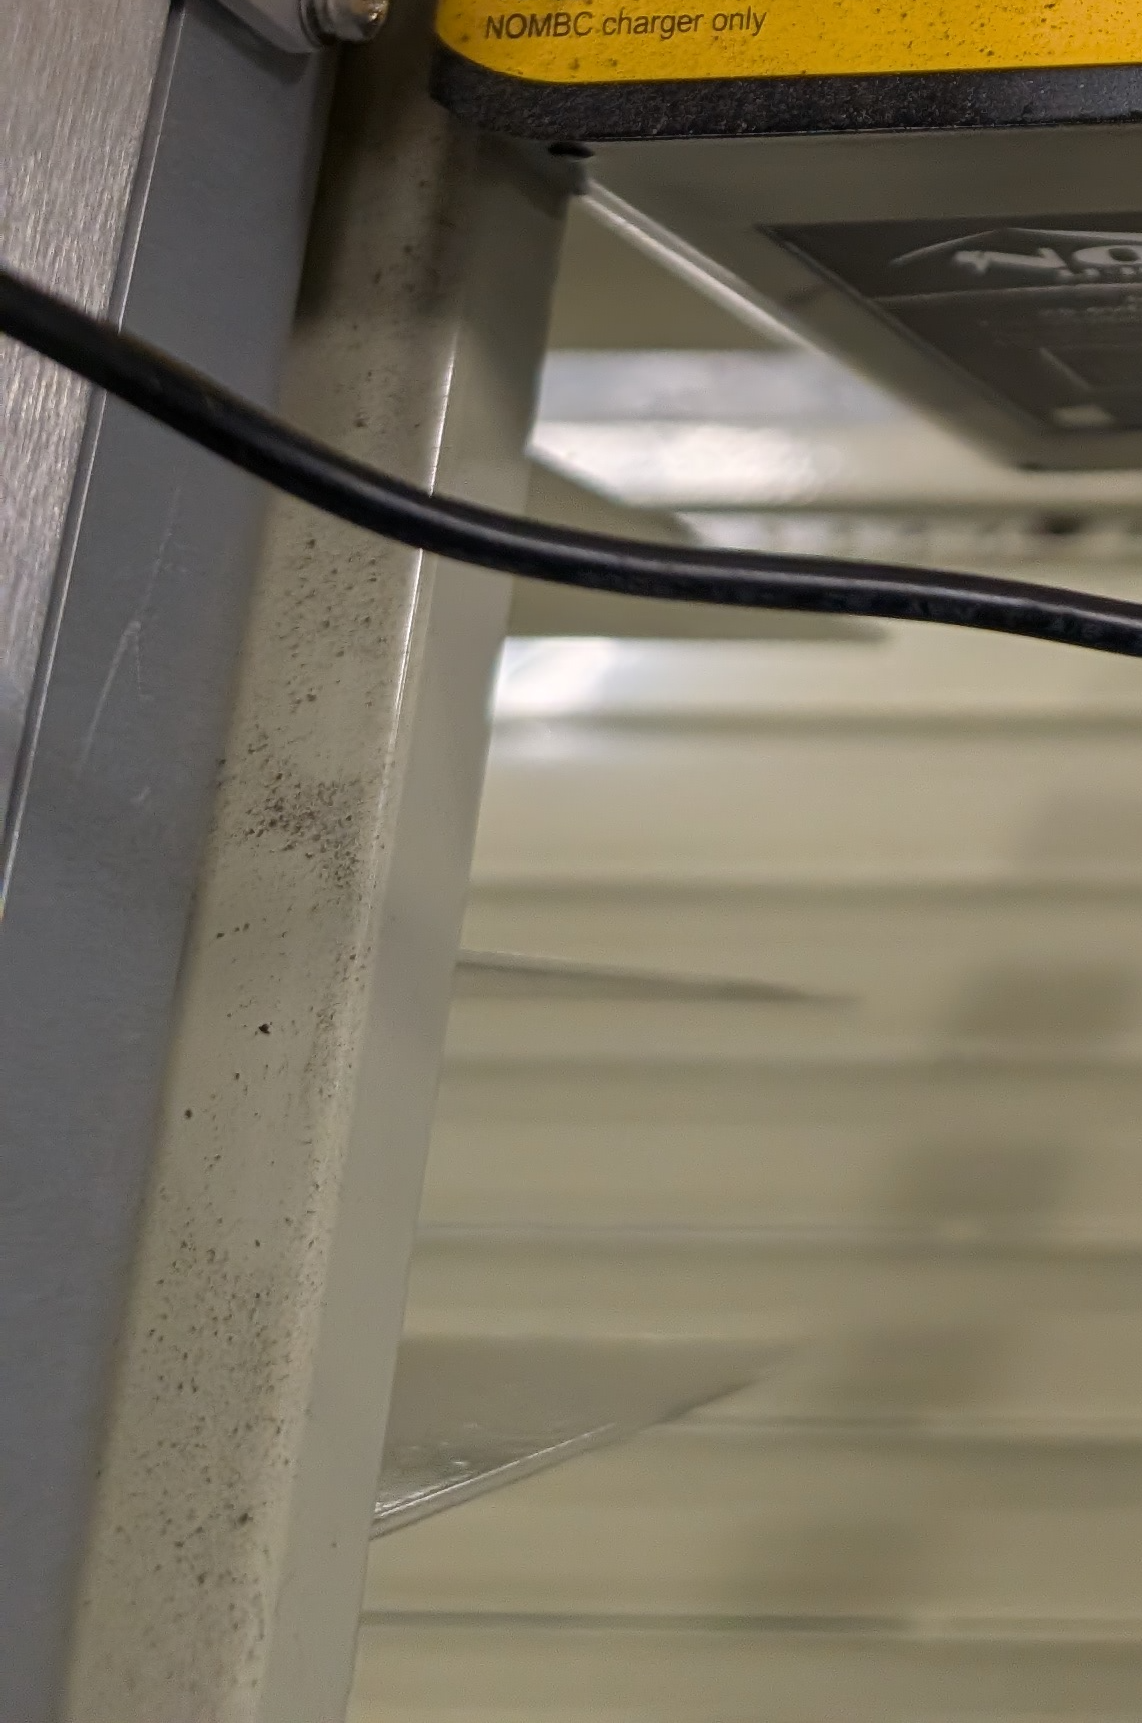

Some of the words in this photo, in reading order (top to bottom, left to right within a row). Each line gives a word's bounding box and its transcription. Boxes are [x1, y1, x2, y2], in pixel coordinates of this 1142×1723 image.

[486, 11, 594, 39] NOMBC
[602, 8, 704, 40] charger
[712, 6, 768, 37] only
